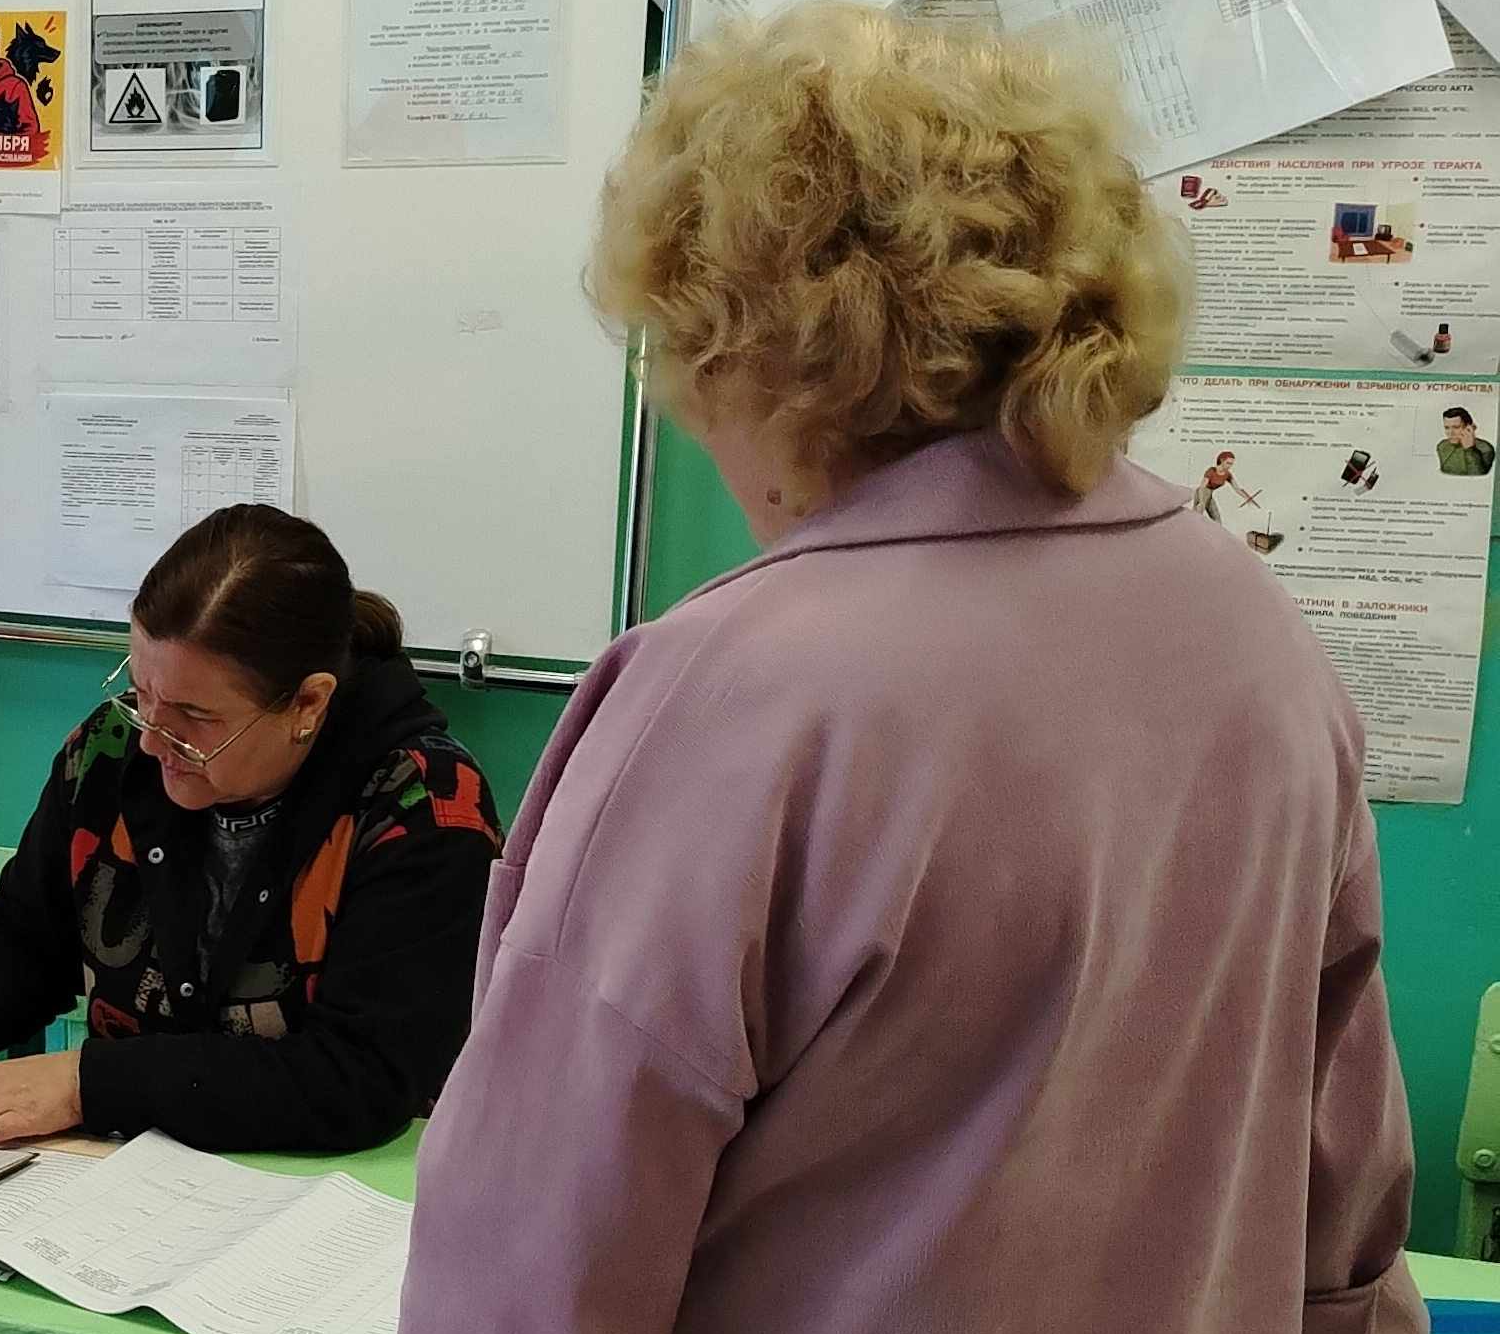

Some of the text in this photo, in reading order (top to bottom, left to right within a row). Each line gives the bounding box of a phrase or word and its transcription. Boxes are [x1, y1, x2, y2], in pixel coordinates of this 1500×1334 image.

[1450, 84, 1474, 92] АКТА
[1211, 160, 1483, 171] ДЕЙСТВИЯ НАСЕЛЕНИЯ ПРИ УГРОЗЕ ТЕРАКТА
[1179, 377, 1493, 393] ЧТО ДЕЛАТЬ ПРИ ОБНАРУЖЕНИИ ВЗРЫВНОГО УСТРОЙСТВА
[1342, 600, 1349, 608] В
[1356, 601, 1428, 613] ЗАЛОЖНИКИ
[1339, 611, 1397, 620] ПОВЕДЕНИЯ
